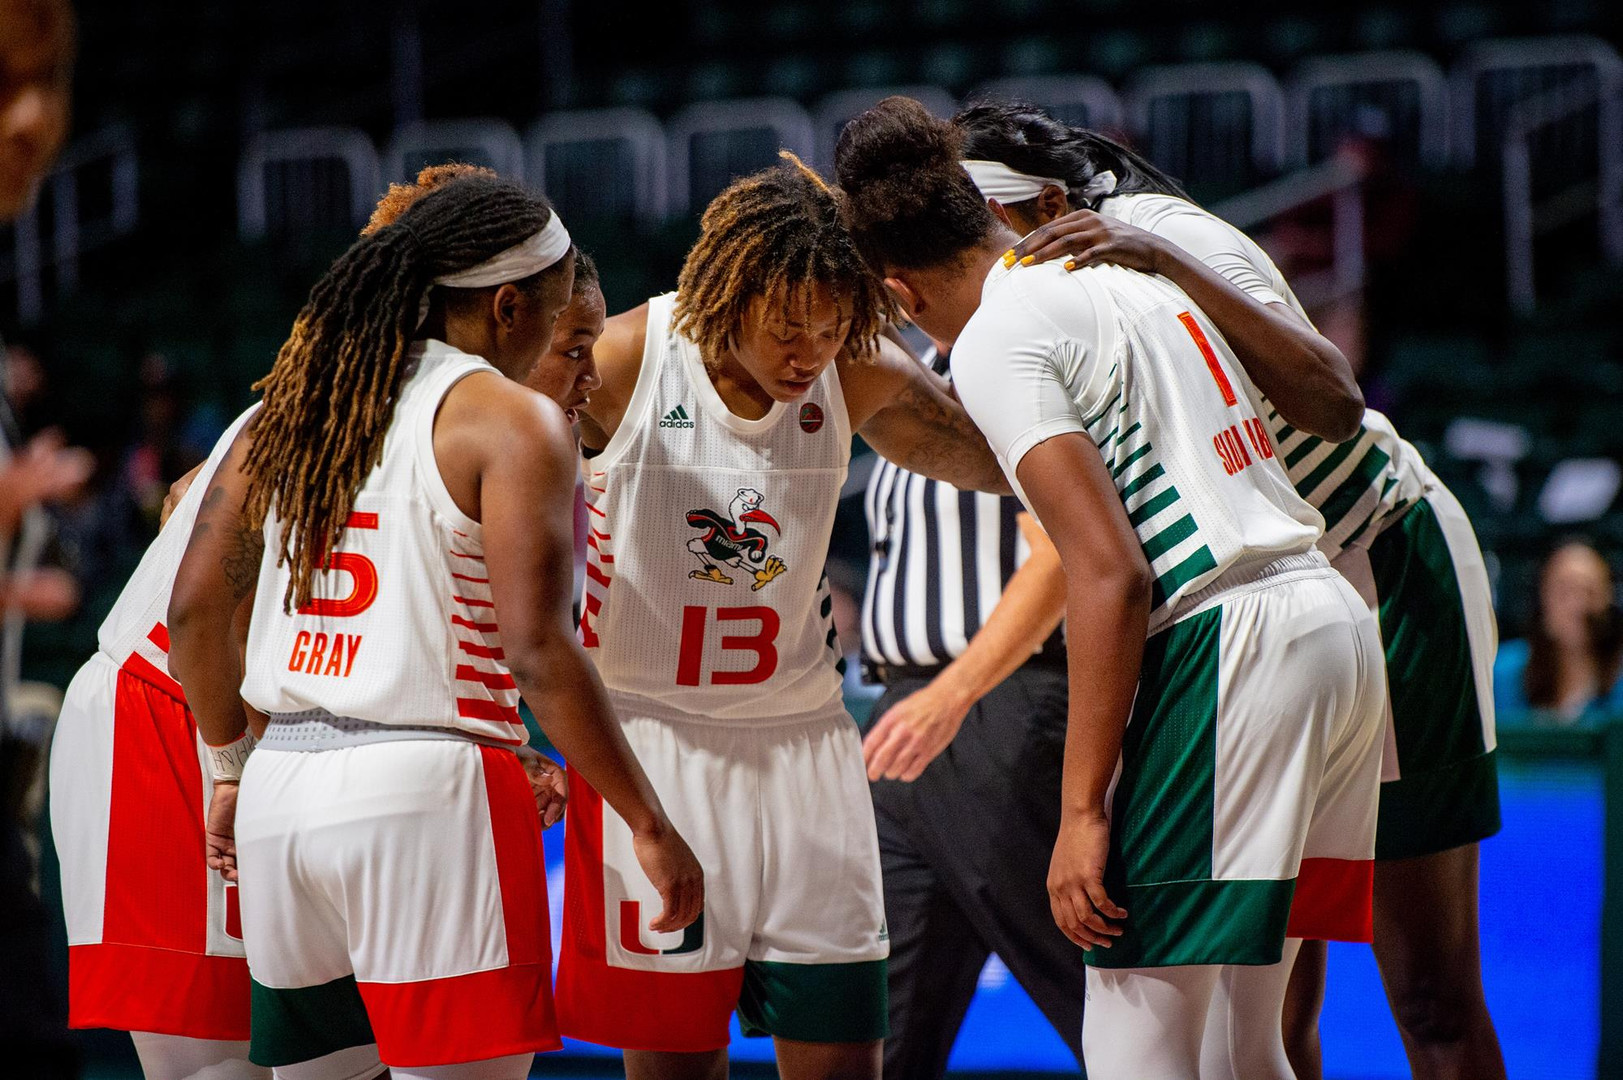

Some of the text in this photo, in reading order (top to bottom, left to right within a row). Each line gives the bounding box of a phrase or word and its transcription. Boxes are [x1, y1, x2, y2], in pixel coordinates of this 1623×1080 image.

[1177, 311, 1238, 407] 1
[659, 418, 695, 429] adidas
[297, 511, 379, 617] 5
[288, 630, 362, 677] GRAY
[676, 606, 780, 687] 13
